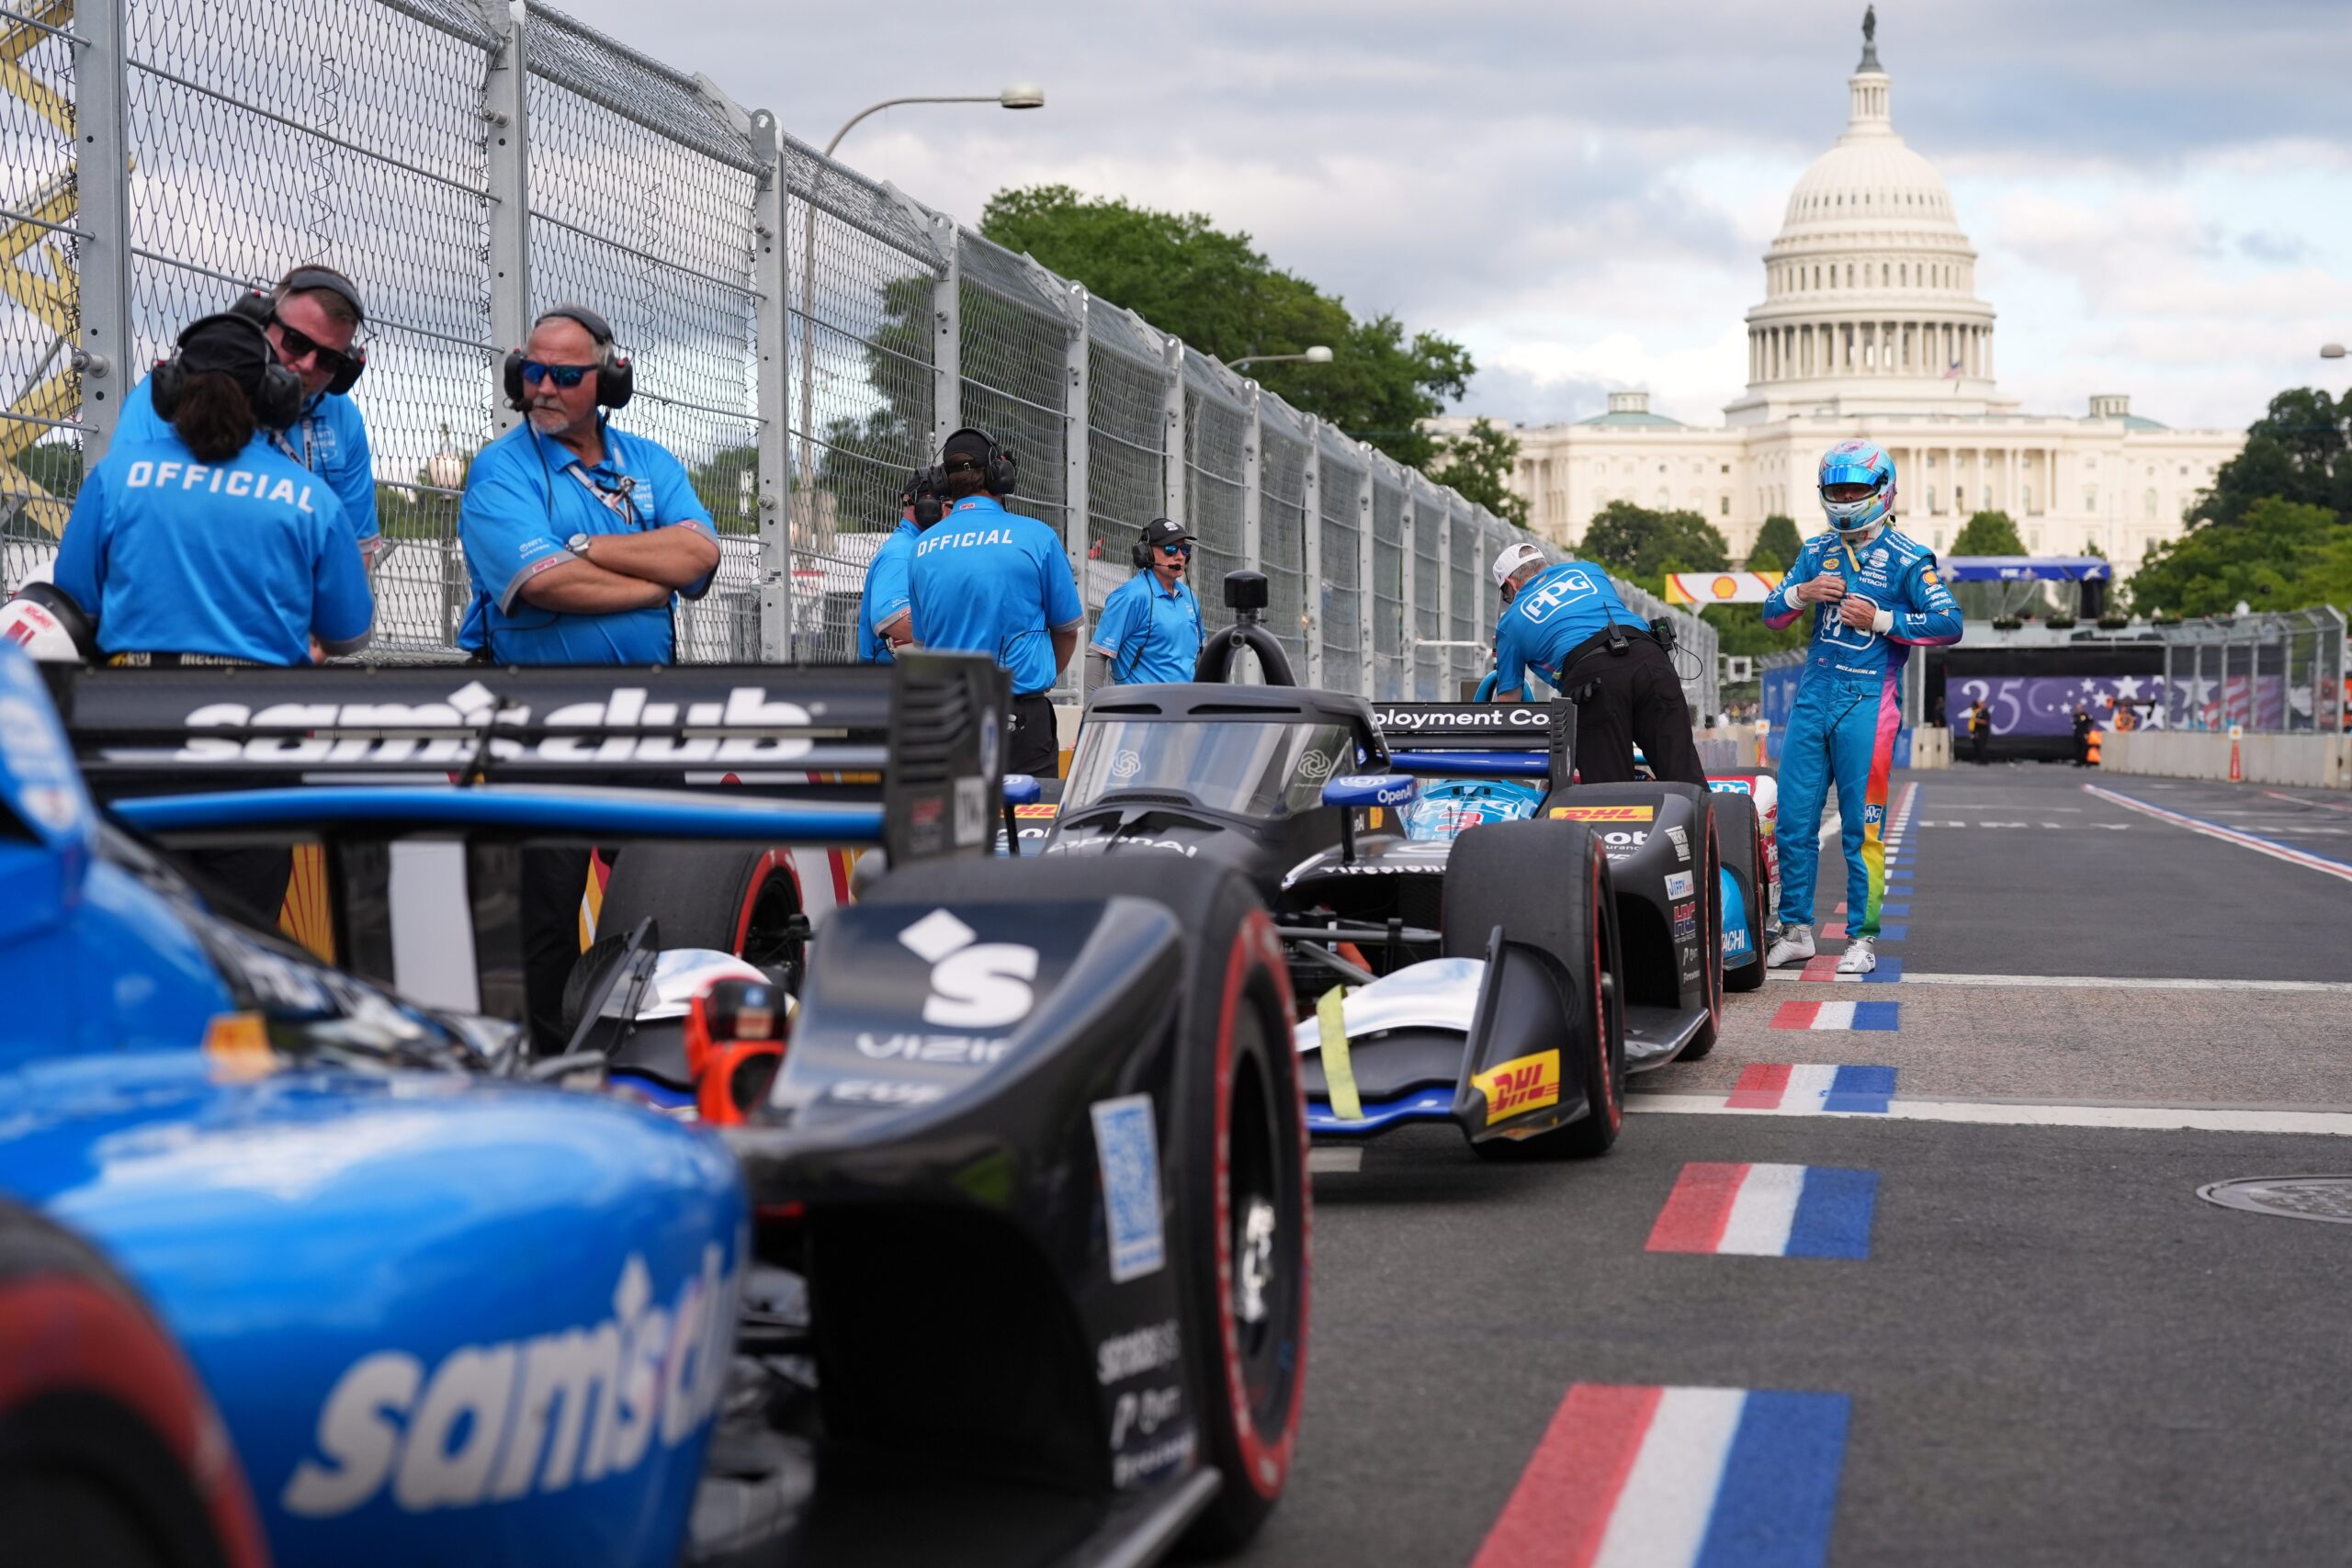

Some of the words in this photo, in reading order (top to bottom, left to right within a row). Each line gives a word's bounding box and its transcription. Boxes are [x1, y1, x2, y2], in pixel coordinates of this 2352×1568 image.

[127, 461, 314, 513] OFFICIAL
[916, 529, 1013, 558] OFFICIAL
[1859, 577, 1888, 589] HITACHI
[1861, 570, 1887, 581] verizon
[1526, 576, 1590, 617] PPG
[1378, 788, 1413, 805] OpenAI
[1565, 808, 1639, 819] DHL
[1866, 806, 1881, 823] PPG
[1493, 1063, 1544, 1111] DHL
